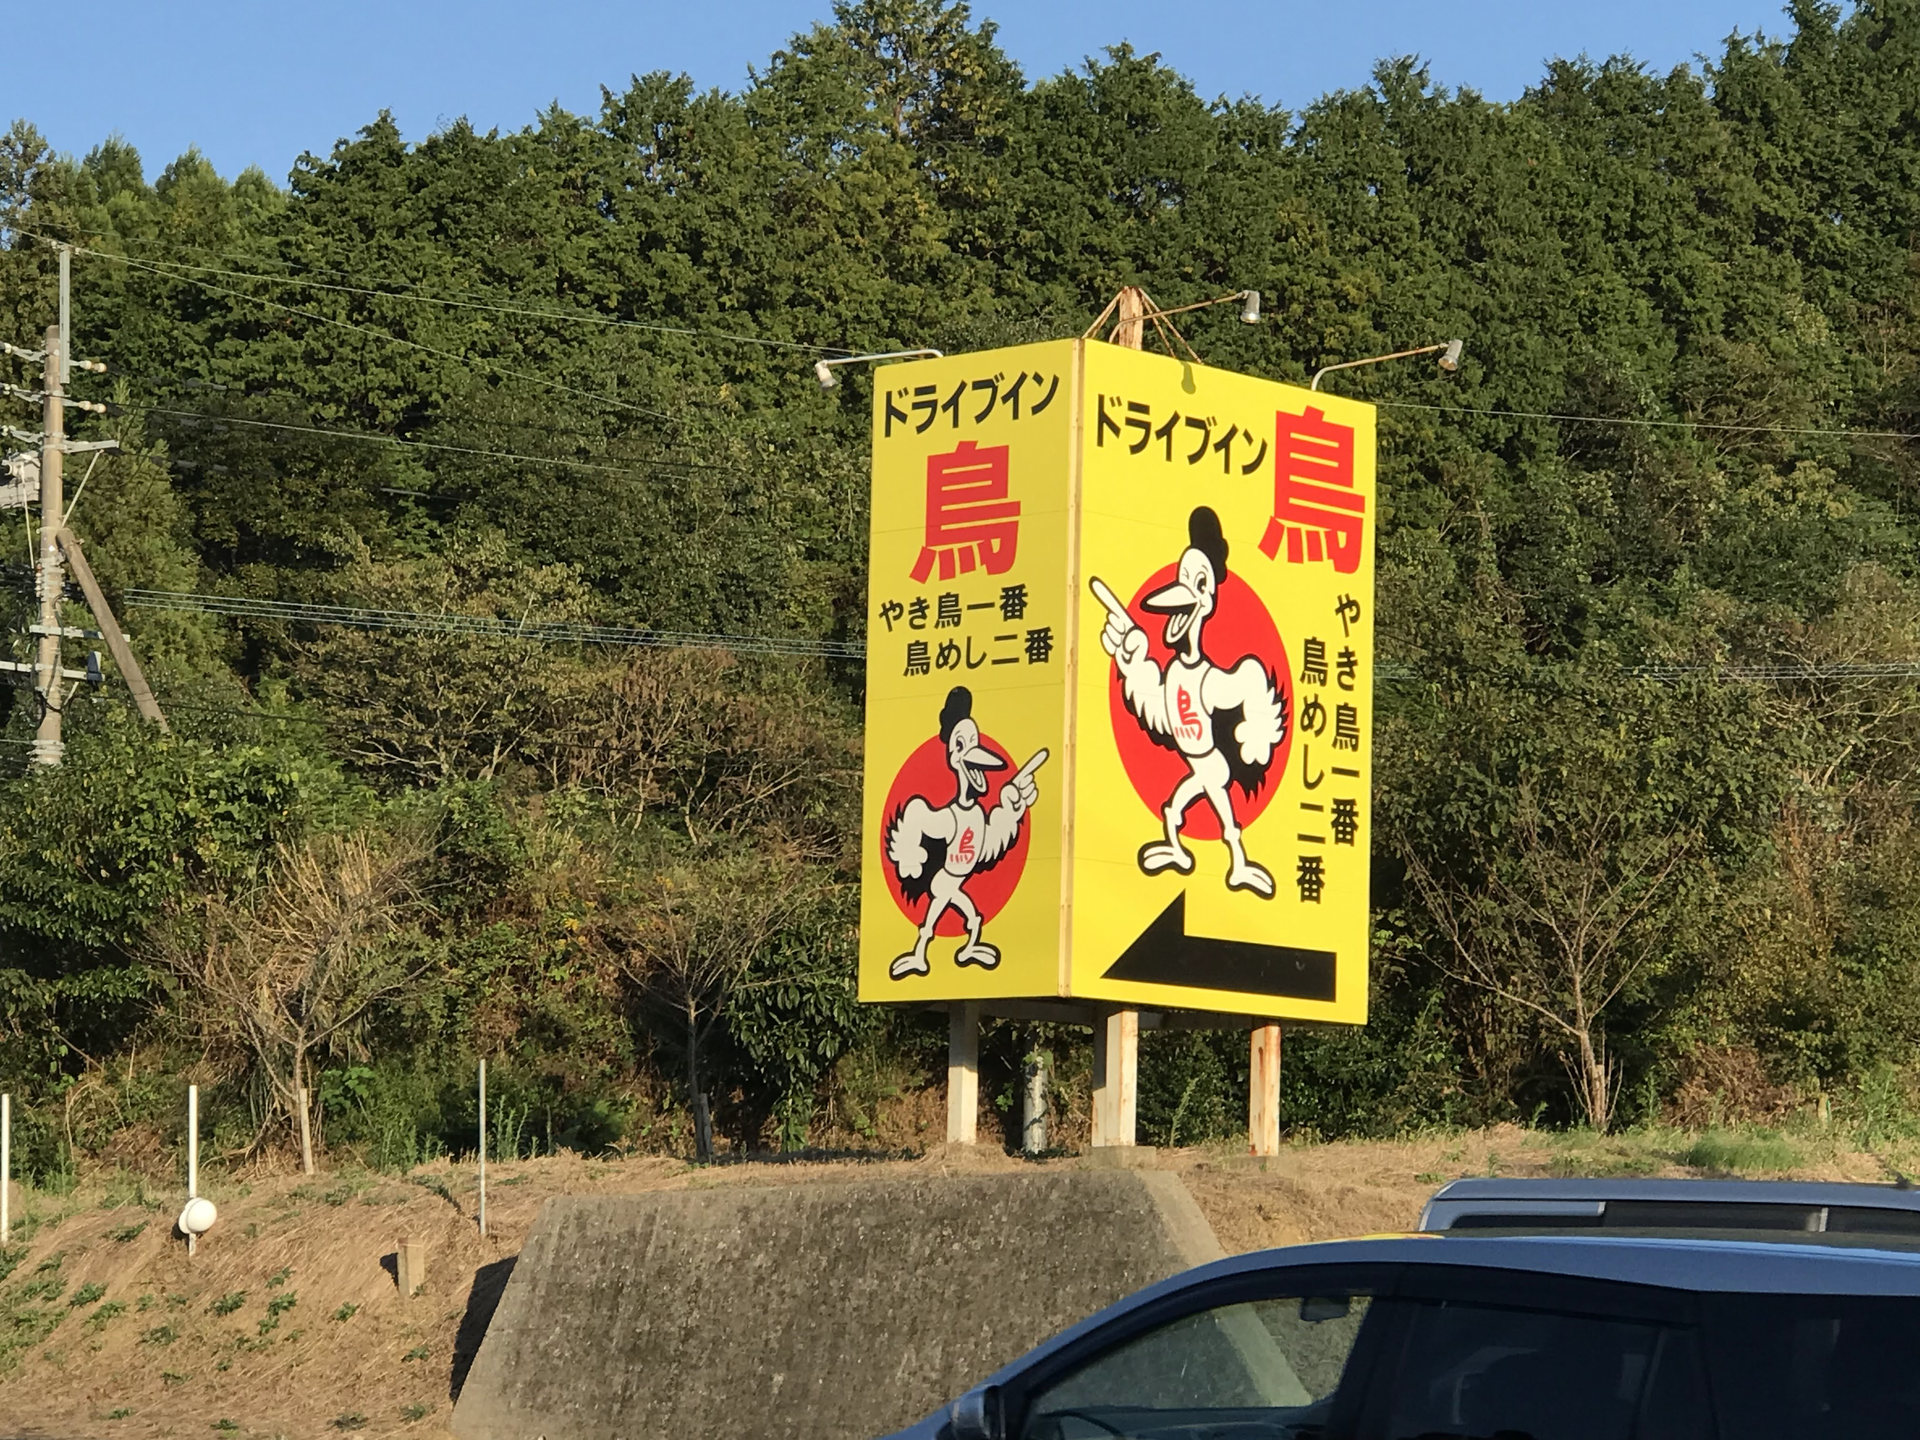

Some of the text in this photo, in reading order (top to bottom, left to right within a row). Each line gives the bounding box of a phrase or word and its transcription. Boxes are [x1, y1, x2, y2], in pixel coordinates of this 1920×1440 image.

[884, 372, 1059, 437] ドライブイン
[1097, 393, 1267, 475] ドライブイン
[909, 440, 1021, 584] 鳥
[1257, 405, 1366, 574] 鳥
[879, 583, 1028, 632] やき鳥一番
[903, 627, 1054, 676] 鳥めし二番
[1296, 636, 1328, 904] 鳥めし二番
[1331, 593, 1361, 847] やき鳥一番
